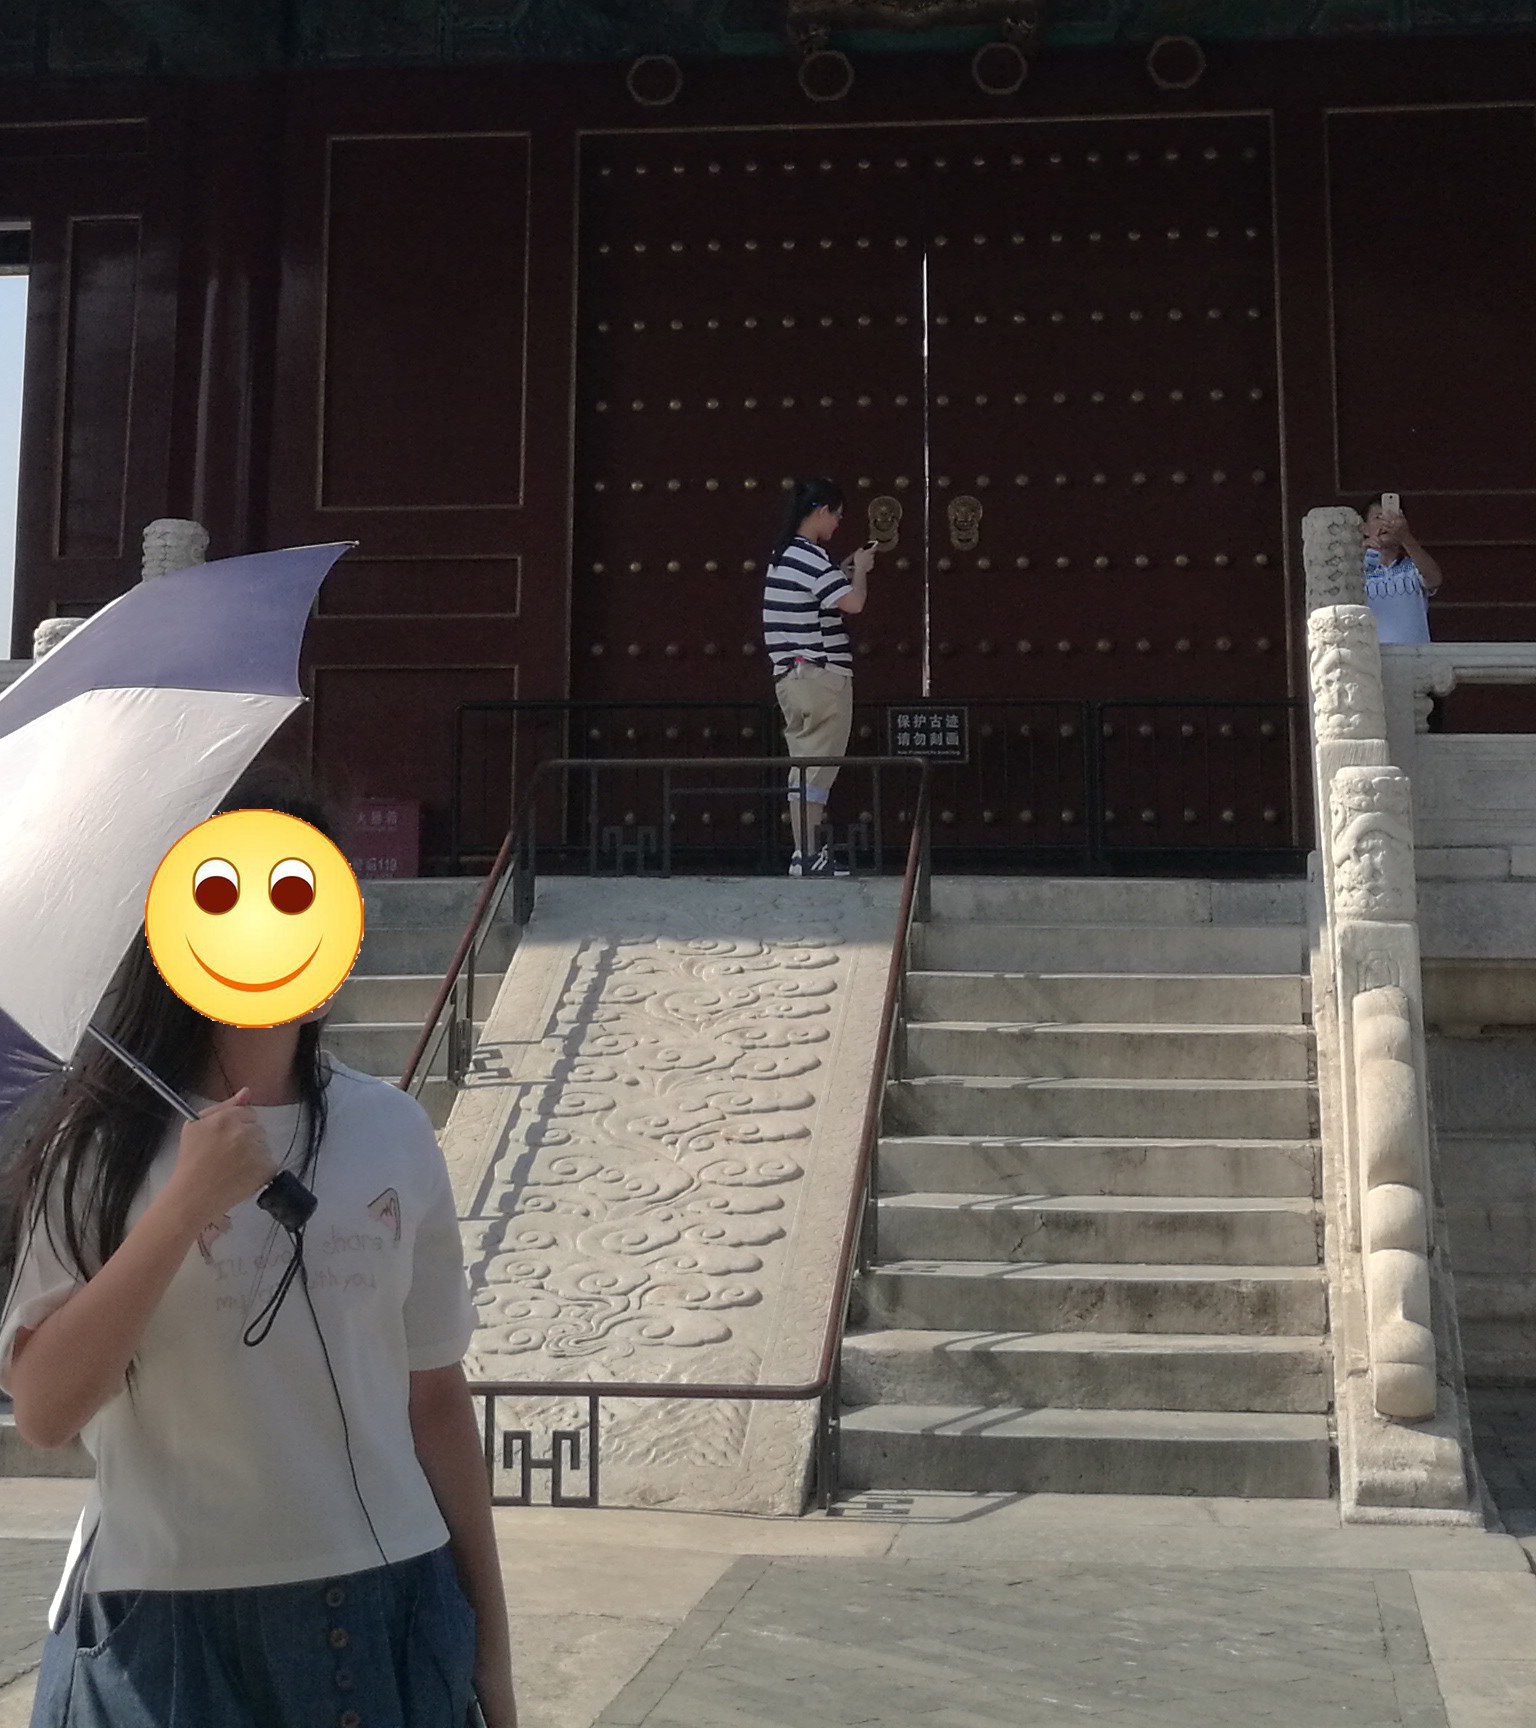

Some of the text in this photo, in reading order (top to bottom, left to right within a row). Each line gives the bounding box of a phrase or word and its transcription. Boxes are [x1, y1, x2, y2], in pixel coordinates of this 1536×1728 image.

[897, 714, 959, 728] 保护古迹
[897, 732, 959, 746] 请勿刻画
[322, 1224, 383, 1256] share
[343, 1272, 376, 1292] you
